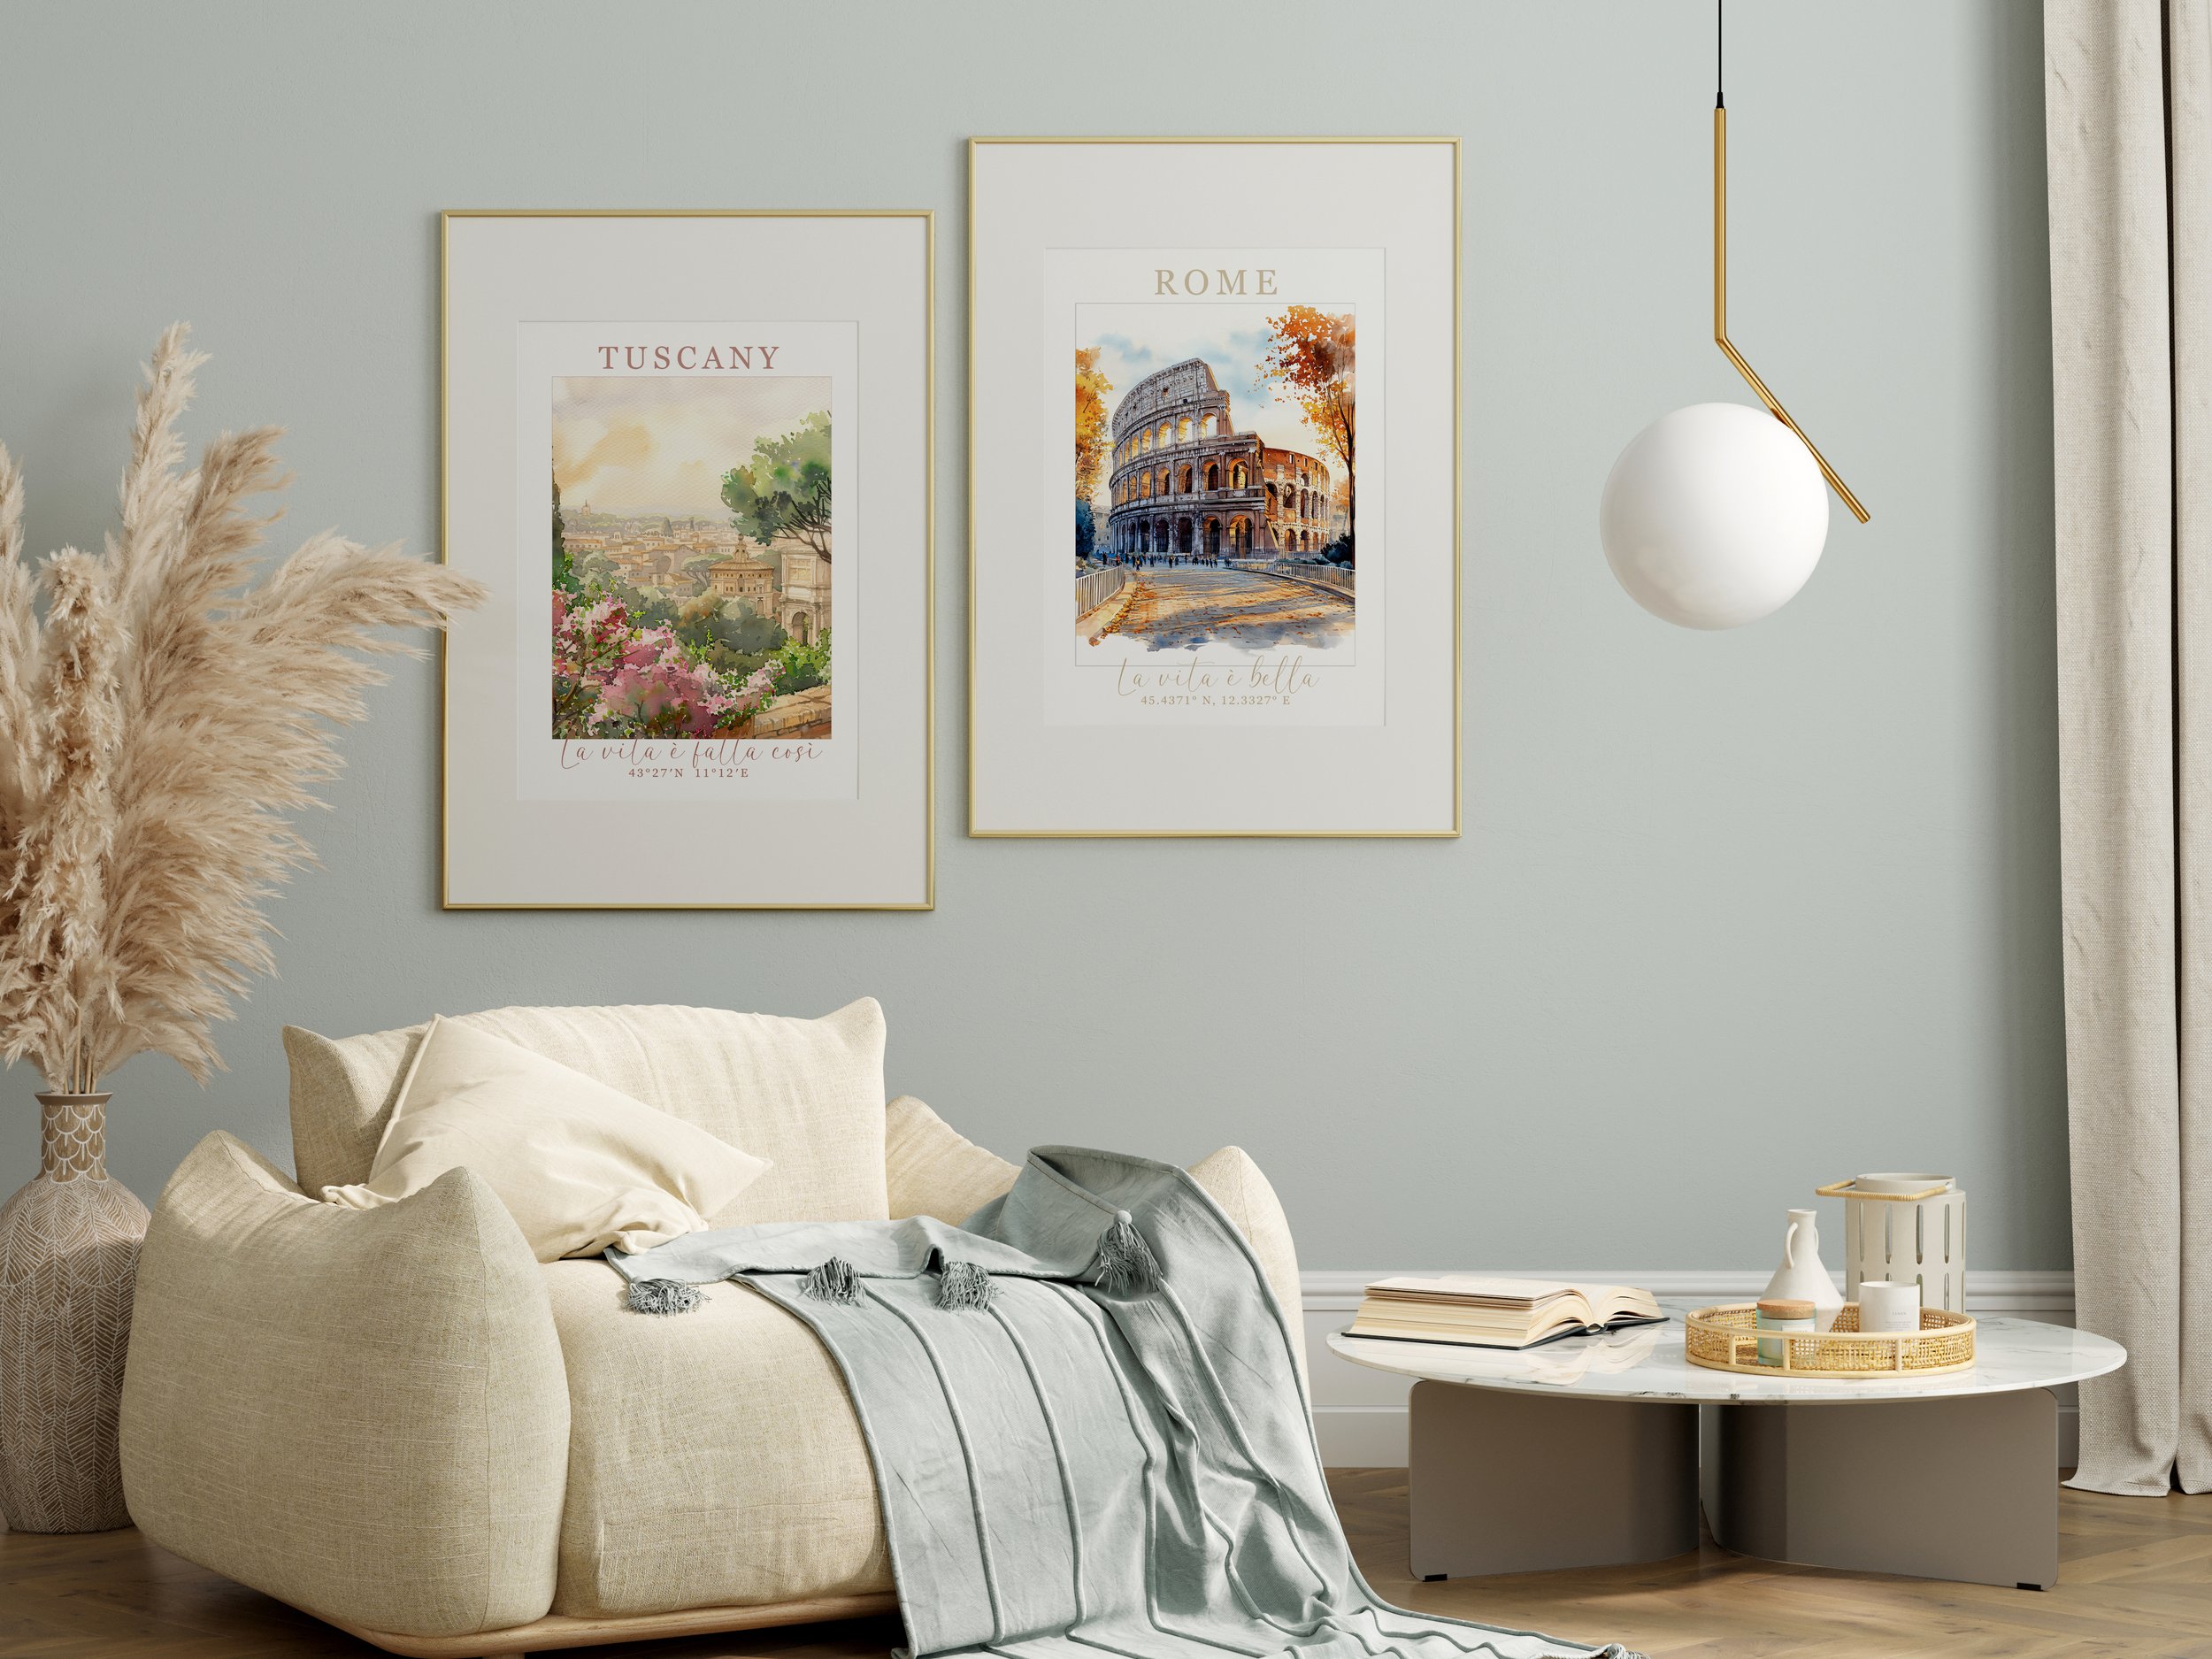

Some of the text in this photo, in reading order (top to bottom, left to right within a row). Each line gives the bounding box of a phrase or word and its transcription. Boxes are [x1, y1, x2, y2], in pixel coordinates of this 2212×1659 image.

[1154, 268, 1279, 296] ROME
[598, 345, 780, 370] TUSCANY
[1118, 657, 1150, 696] La
[1158, 657, 1219, 693] vita
[1248, 655, 1320, 694] bella
[1282, 695, 1291, 706] E
